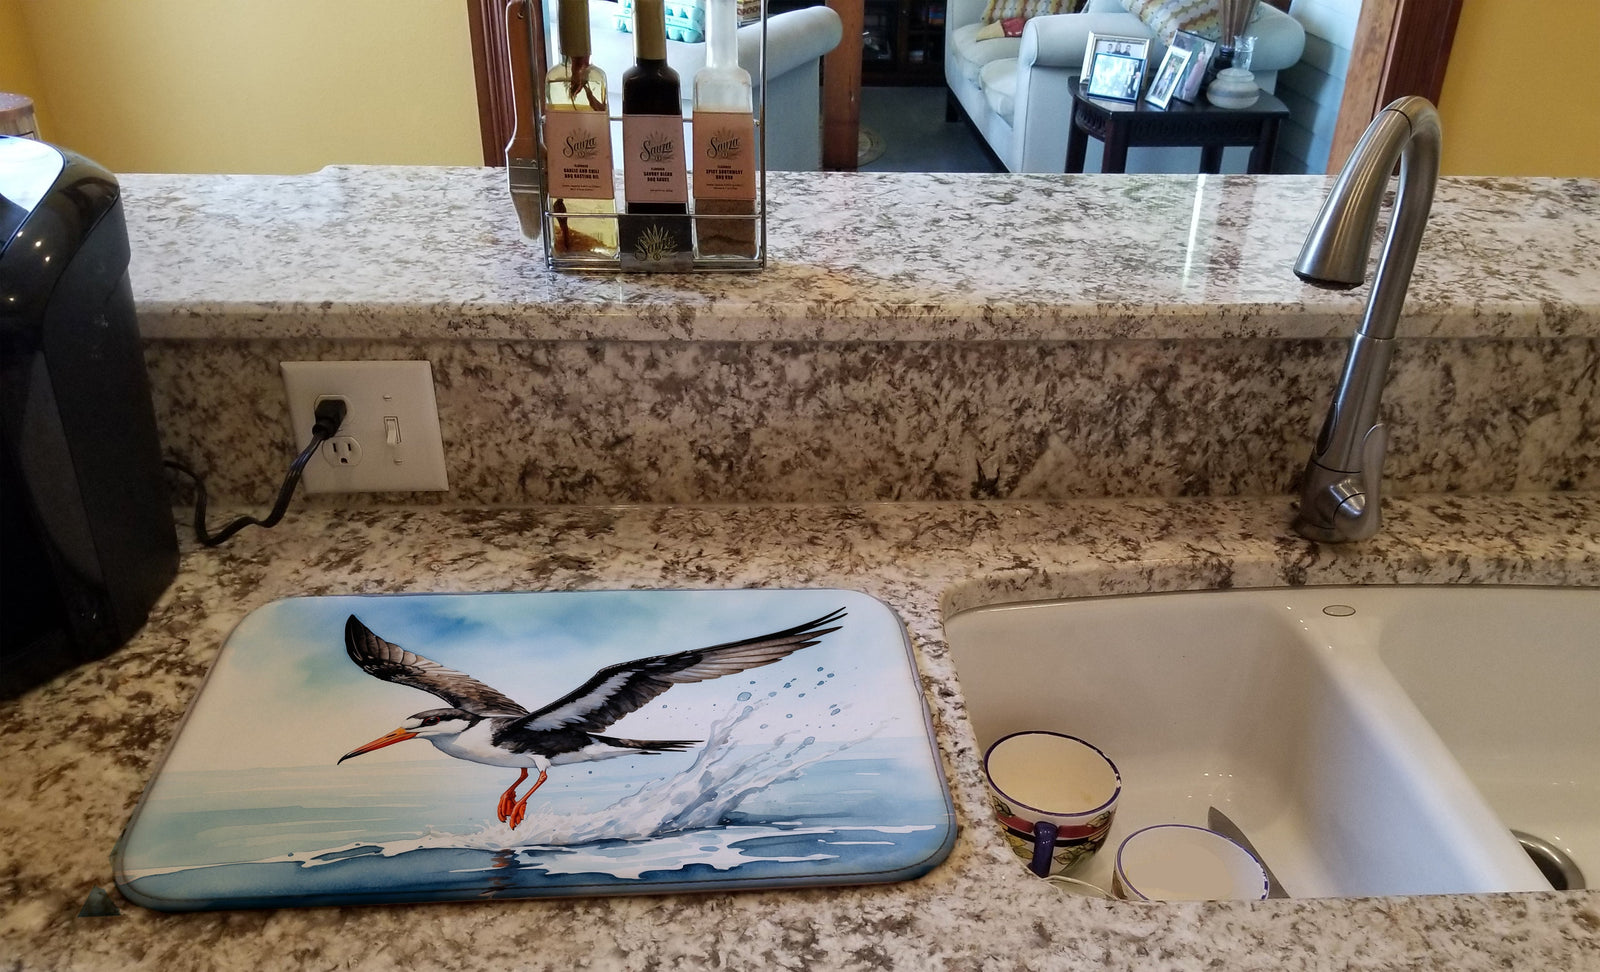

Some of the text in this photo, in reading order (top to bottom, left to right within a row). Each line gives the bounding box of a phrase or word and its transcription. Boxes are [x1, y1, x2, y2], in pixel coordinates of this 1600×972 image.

[563, 136, 597, 158] Sauza
[640, 140, 674, 161] Sauza
[707, 137, 739, 158] Sauza
